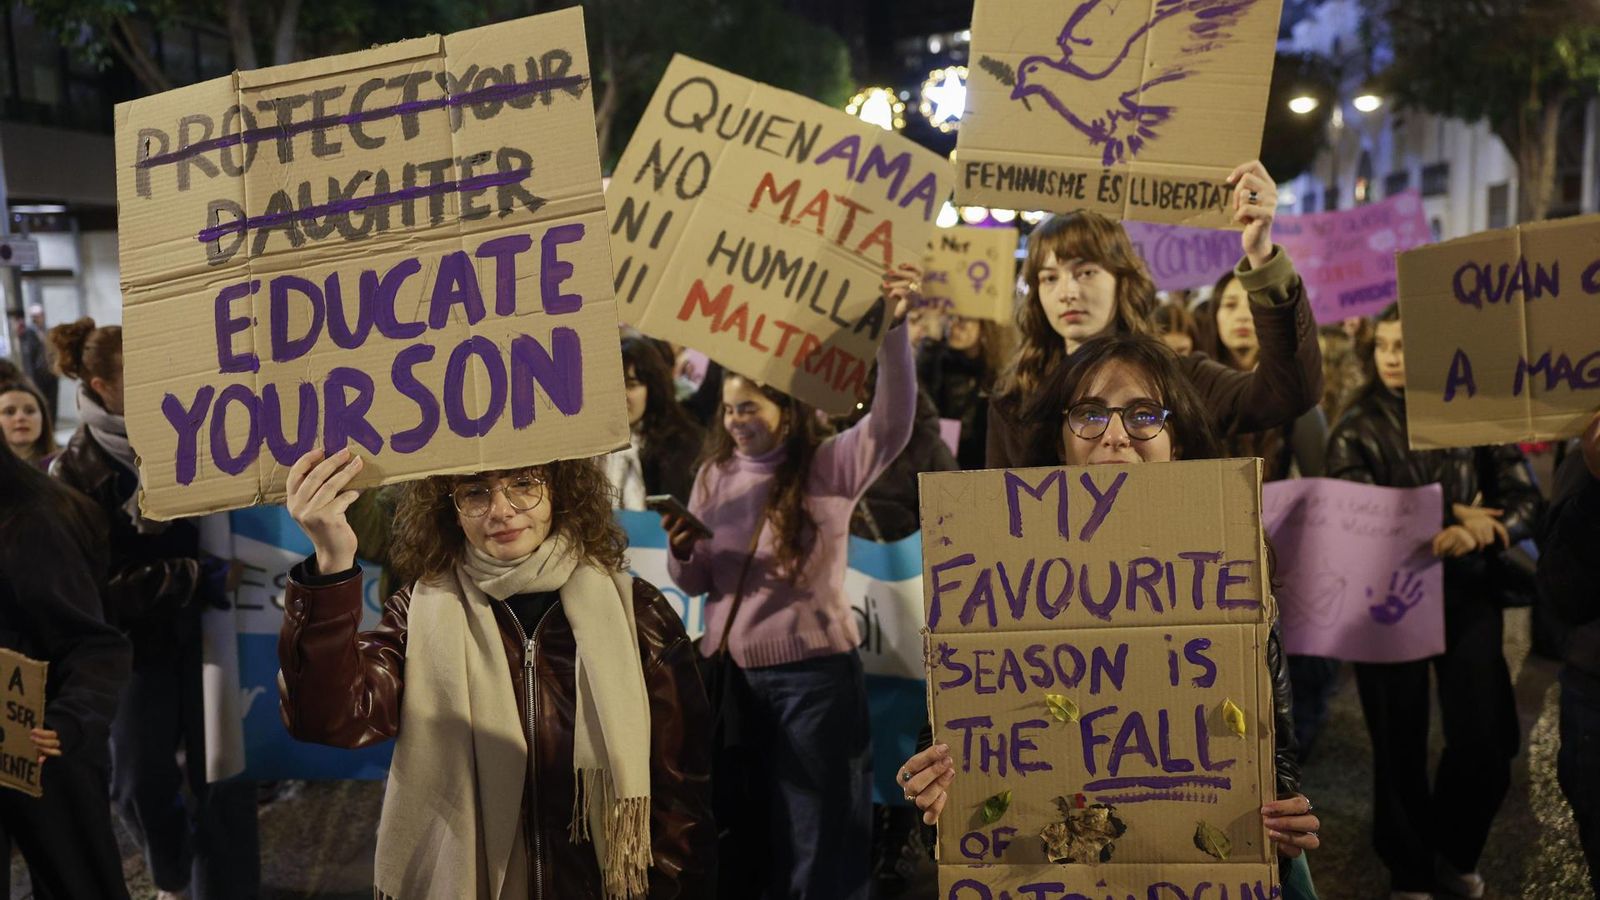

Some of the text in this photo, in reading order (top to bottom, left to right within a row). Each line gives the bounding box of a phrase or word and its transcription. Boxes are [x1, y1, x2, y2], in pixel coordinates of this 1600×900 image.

[135, 49, 589, 198] PROTECT YOUR
[664, 76, 938, 222] QUIEN AMA
[206, 147, 547, 266] DAUGHTER
[633, 138, 895, 273] NO MATA
[965, 162, 1236, 213] FEMINISME ÉS LLIBERTAT
[214, 223, 586, 374] EDUCATE
[611, 196, 886, 342] NI HUMILLA
[1453, 254, 1559, 310] QUAN
[677, 278, 867, 402] MALTRATA
[1444, 347, 1477, 402] A
[161, 326, 584, 486] YOUR SON
[1004, 470, 1129, 542] MY
[927, 551, 1262, 632] FAVOURITE
[8, 666, 24, 696] A
[939, 642, 1129, 695] SEASON
[6, 701, 36, 729] SER
[945, 704, 1237, 778] THE FALL
[959, 826, 1018, 860] OF
